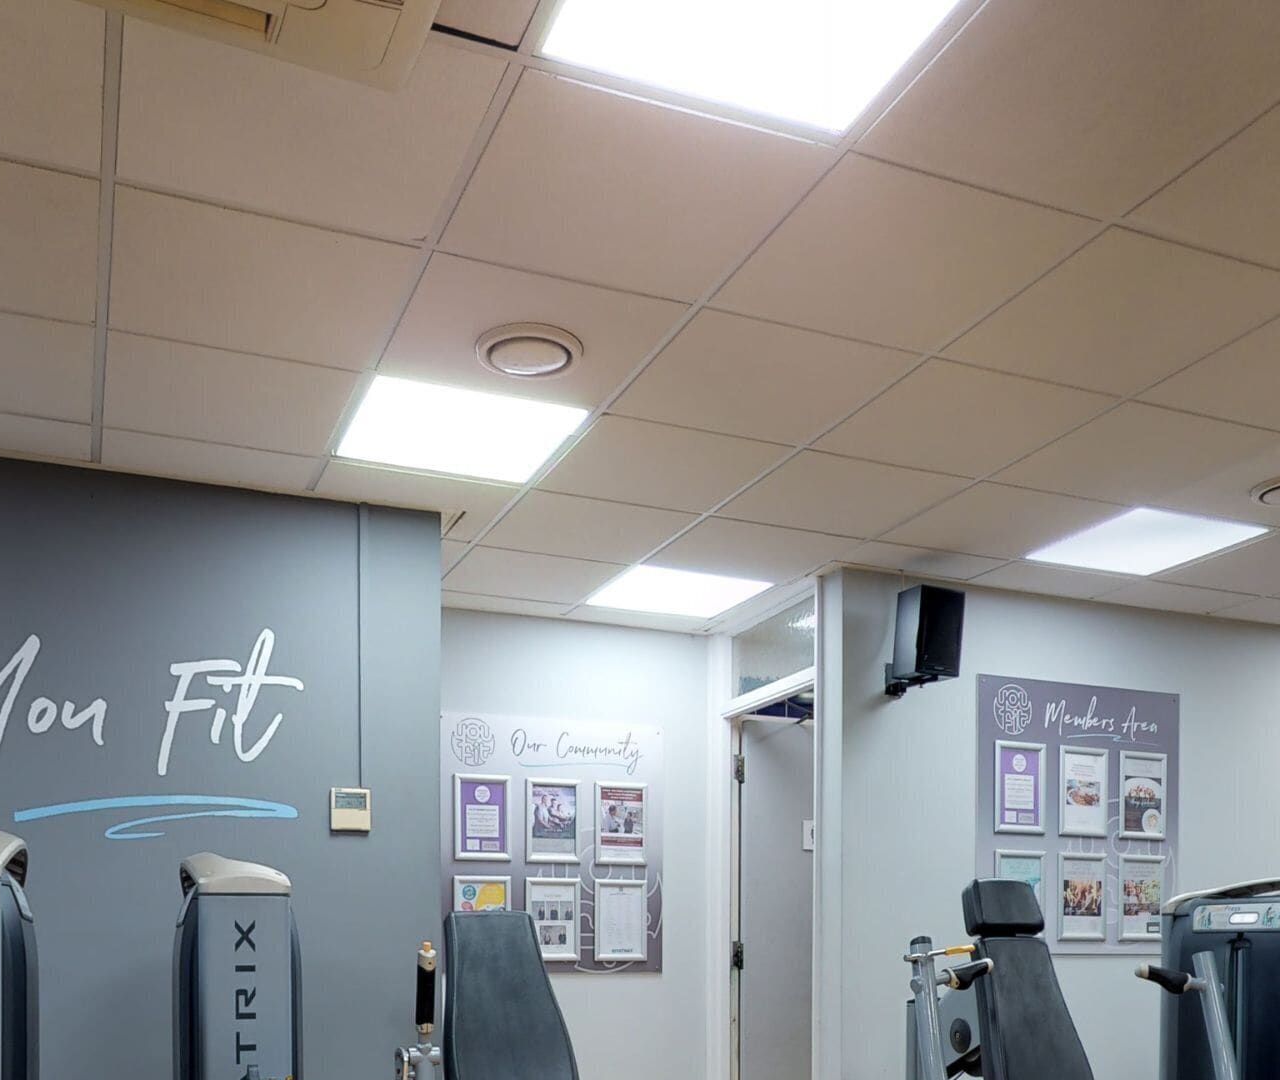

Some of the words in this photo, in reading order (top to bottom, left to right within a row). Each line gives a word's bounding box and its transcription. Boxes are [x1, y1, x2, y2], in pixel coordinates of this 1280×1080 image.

[155, 627, 304, 775] Fit
[1044, 695, 1115, 736] Members
[1121, 705, 1158, 742] Area
[511, 728, 547, 757] Our
[556, 731, 643, 776] Community
